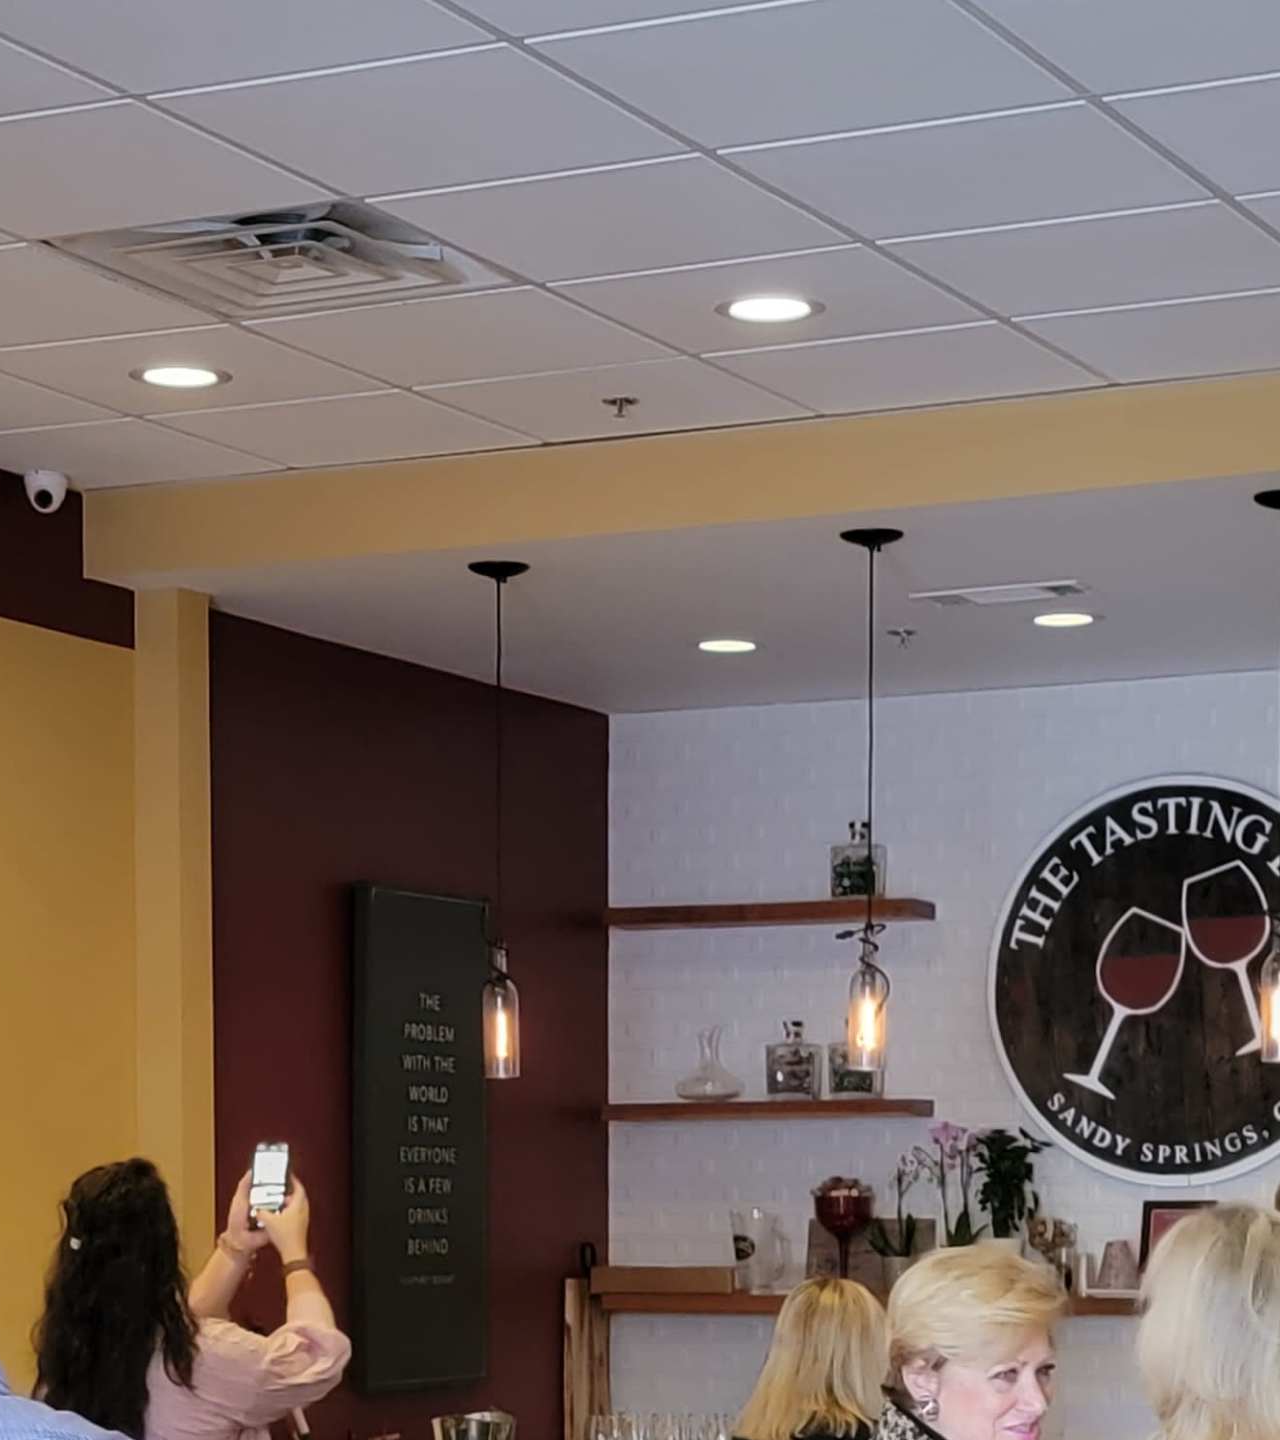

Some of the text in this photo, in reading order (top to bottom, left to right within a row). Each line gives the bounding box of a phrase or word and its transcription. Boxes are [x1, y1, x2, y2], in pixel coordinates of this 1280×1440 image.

[1010, 860, 1080, 951] THE
[1070, 796, 1273, 867] TASTING
[418, 992, 441, 1011] THE
[403, 1023, 455, 1041] PROBLEM
[401, 1054, 457, 1073] WITH THE
[407, 1085, 449, 1103] WORLD
[407, 1114, 450, 1133] IS THAT
[1047, 1091, 1131, 1156] SANDY
[1139, 1123, 1270, 1165] SPRINGS,
[399, 1146, 457, 1165] EVERYONE
[404, 1177, 452, 1194] IS A FEW
[407, 1207, 449, 1225] DRINKS
[407, 1238, 449, 1256] BEHIND
